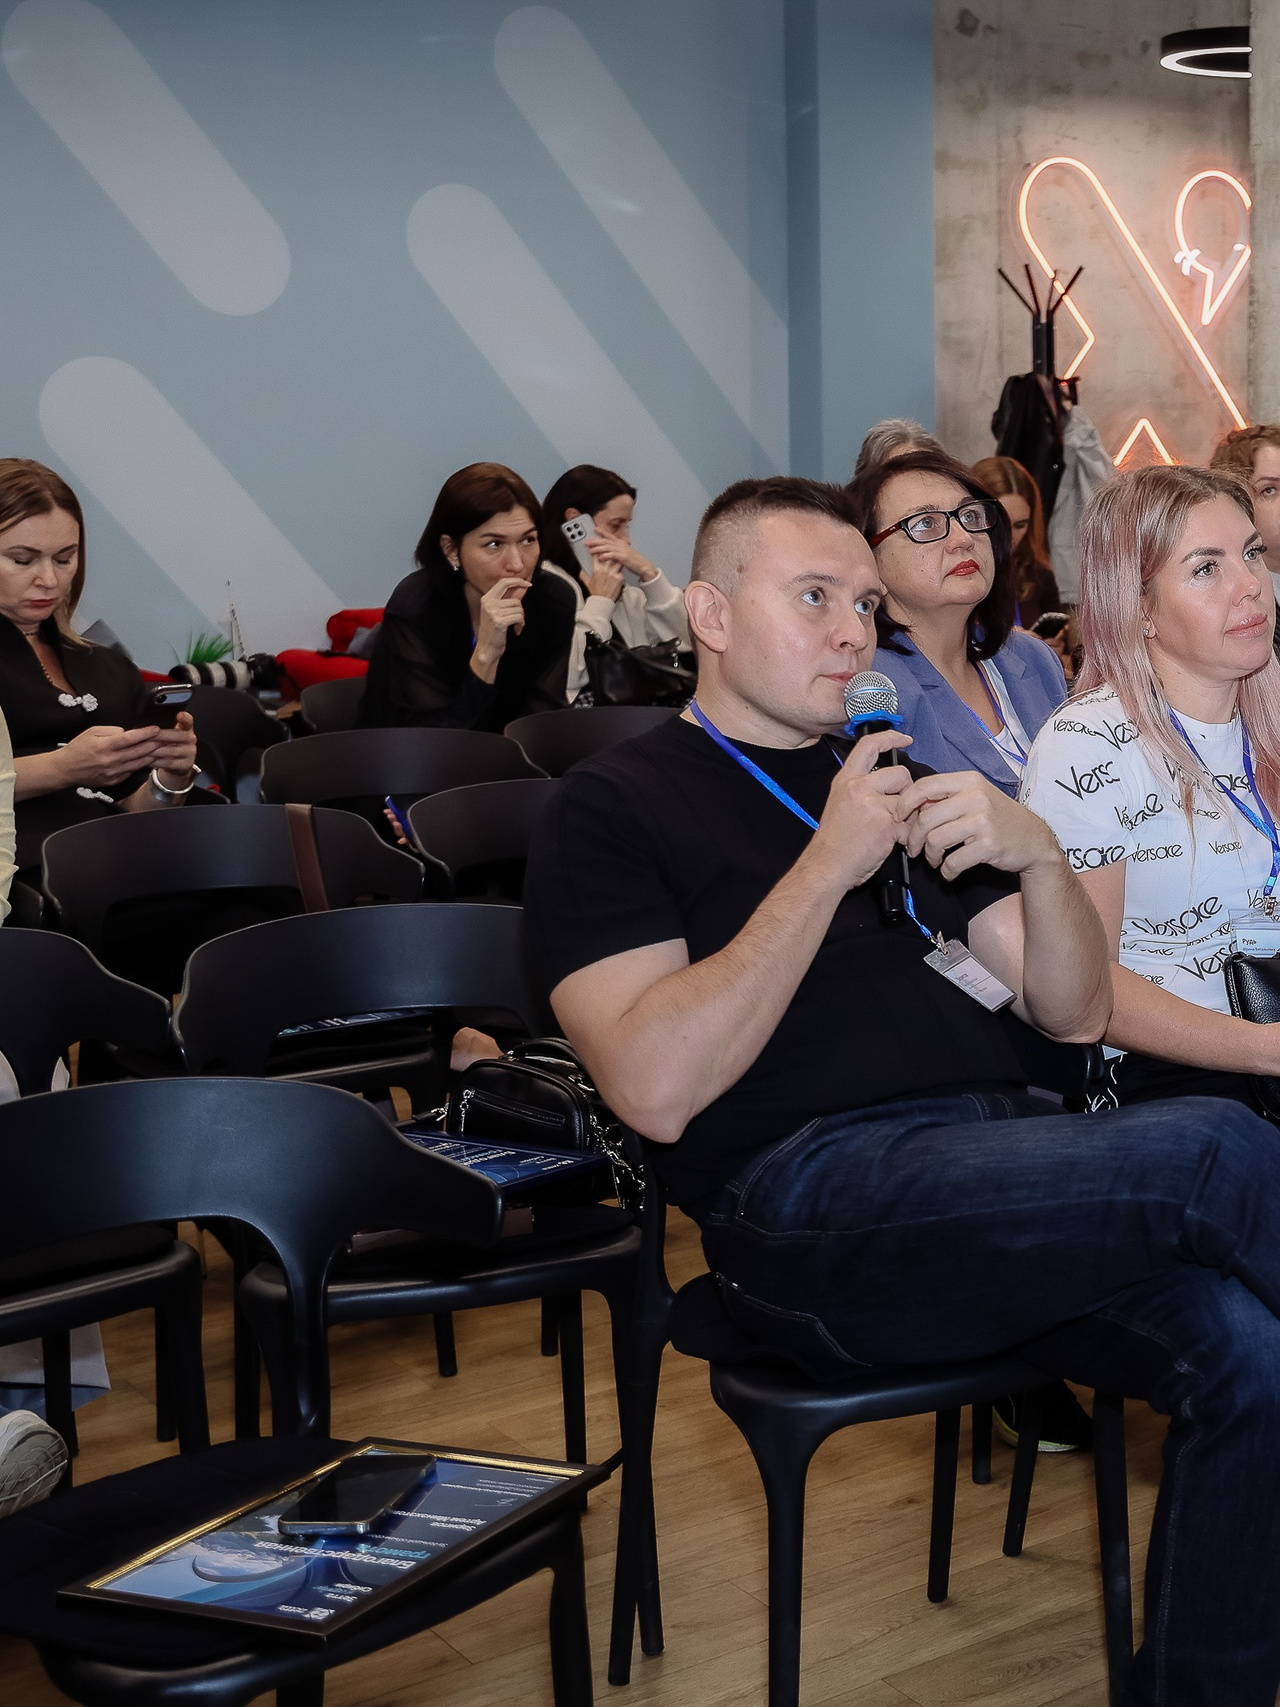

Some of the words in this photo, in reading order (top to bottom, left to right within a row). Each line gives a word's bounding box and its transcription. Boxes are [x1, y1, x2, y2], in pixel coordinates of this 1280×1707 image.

[1065, 845, 1126, 869] rsace
[1131, 842, 1183, 863] Versace
[1208, 841, 1242, 855] Versace
[1131, 896, 1222, 937] Versace
